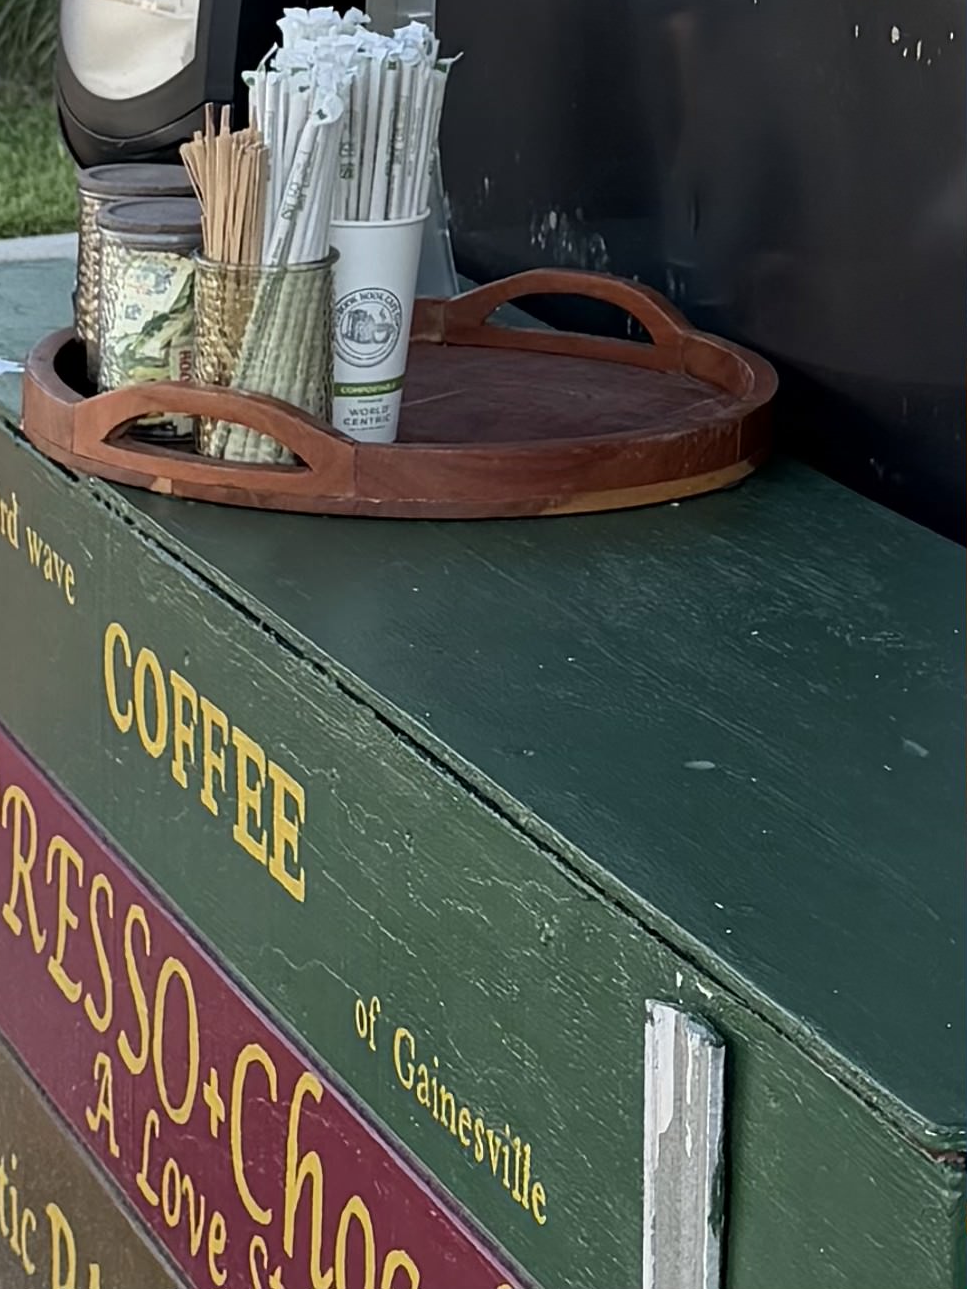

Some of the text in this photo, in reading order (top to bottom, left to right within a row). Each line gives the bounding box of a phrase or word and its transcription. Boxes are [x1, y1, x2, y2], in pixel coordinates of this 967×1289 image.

[342, 413, 391, 426] CENTRIC
[347, 404, 390, 416] WORLD
[26, 526, 75, 605] wave
[104, 622, 306, 901] COFFEE
[85, 1052, 120, 1158] A
[136, 1109, 228, 1287] Love
[355, 995, 547, 1225] of Gainesville
